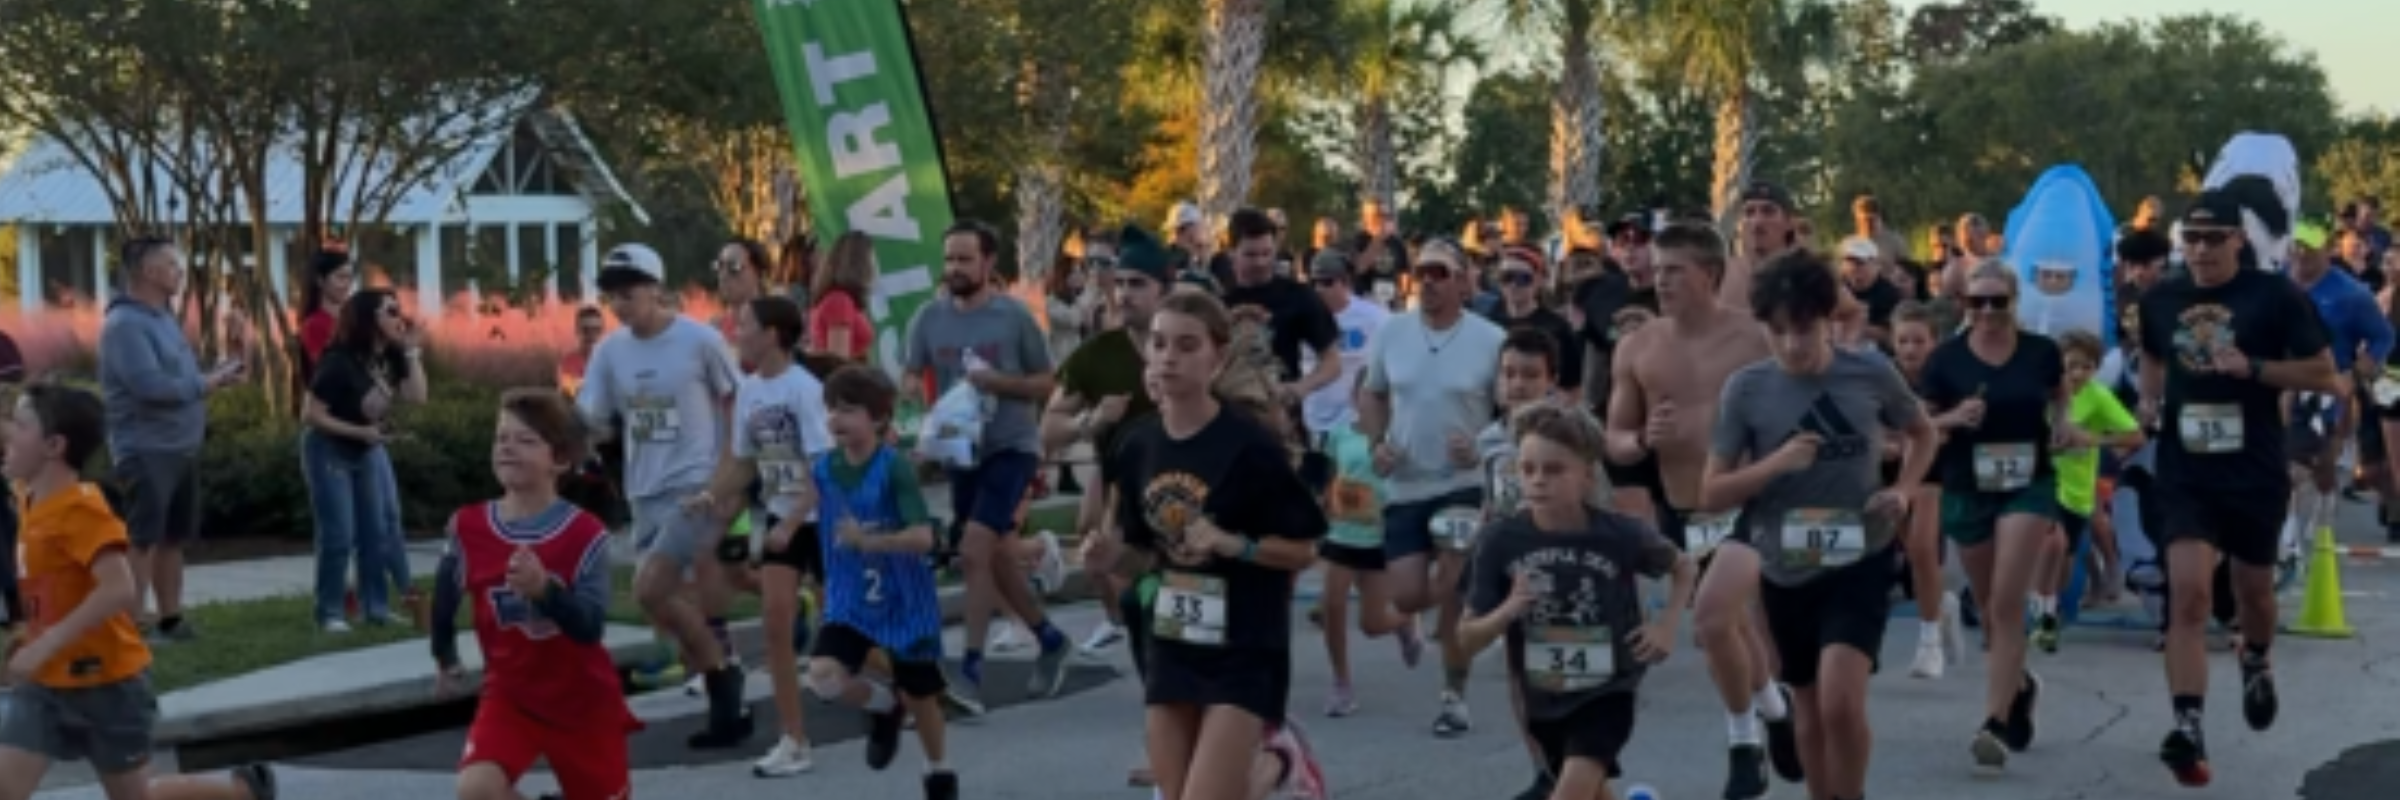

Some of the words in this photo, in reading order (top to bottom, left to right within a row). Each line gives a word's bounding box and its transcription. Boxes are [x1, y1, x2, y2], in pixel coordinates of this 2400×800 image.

[864, 568, 883, 602] 2
[1171, 593, 1204, 625] 33
[1548, 645, 1588, 672] 34
